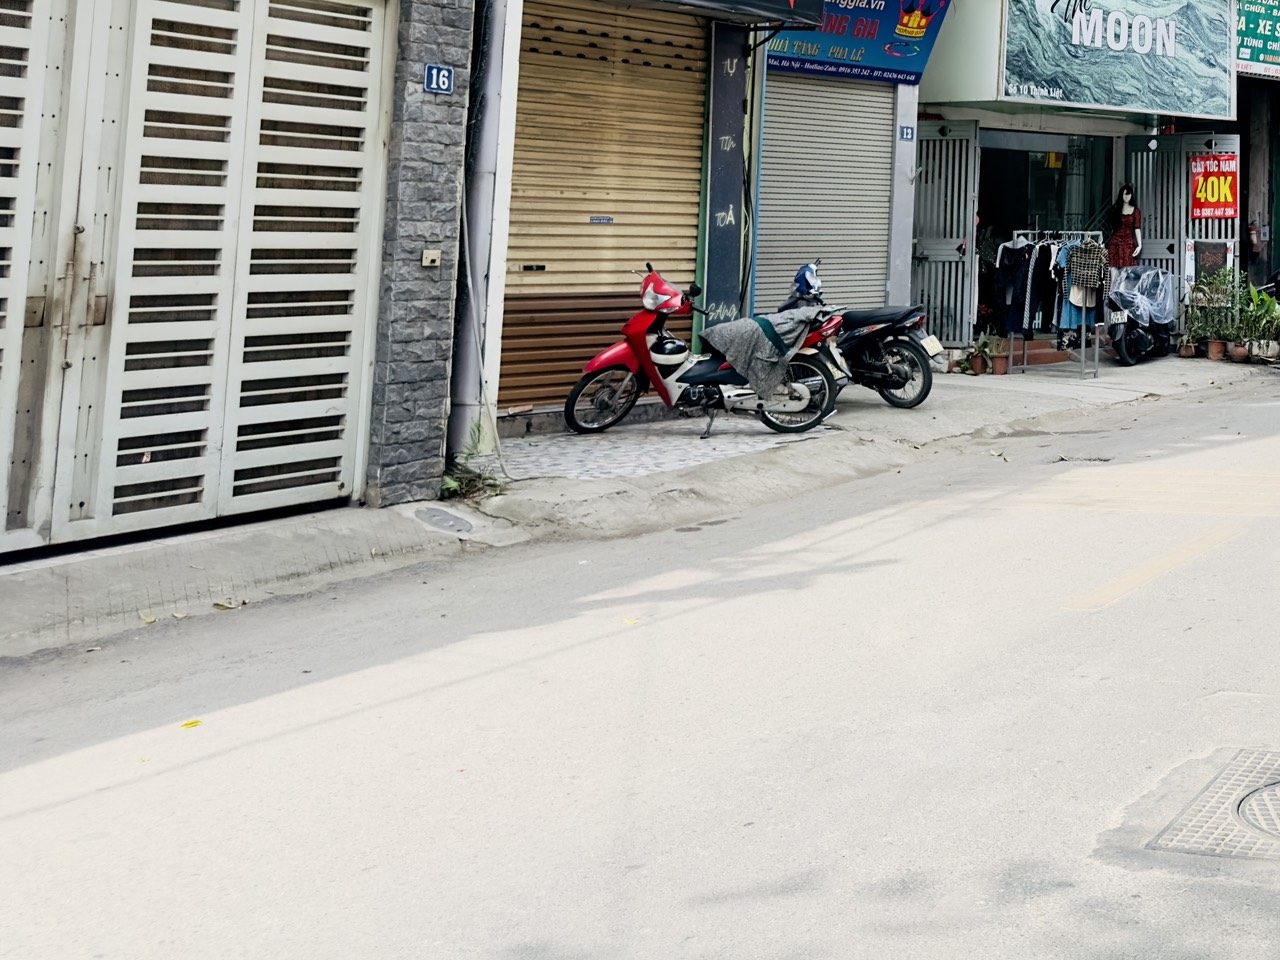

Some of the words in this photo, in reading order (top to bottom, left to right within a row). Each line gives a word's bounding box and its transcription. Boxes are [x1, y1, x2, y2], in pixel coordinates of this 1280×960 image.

[817, 9, 850, 37] ÀNG
[851, 16, 880, 41] GIA
[1071, 8, 1176, 57] MOON
[1256, 19, 1273, 35] XE
[430, 68, 449, 90] 16
[1049, 86, 1063, 98] Liệt
[1220, 160, 1236, 172] NAM
[1195, 176, 1233, 203] 40K
